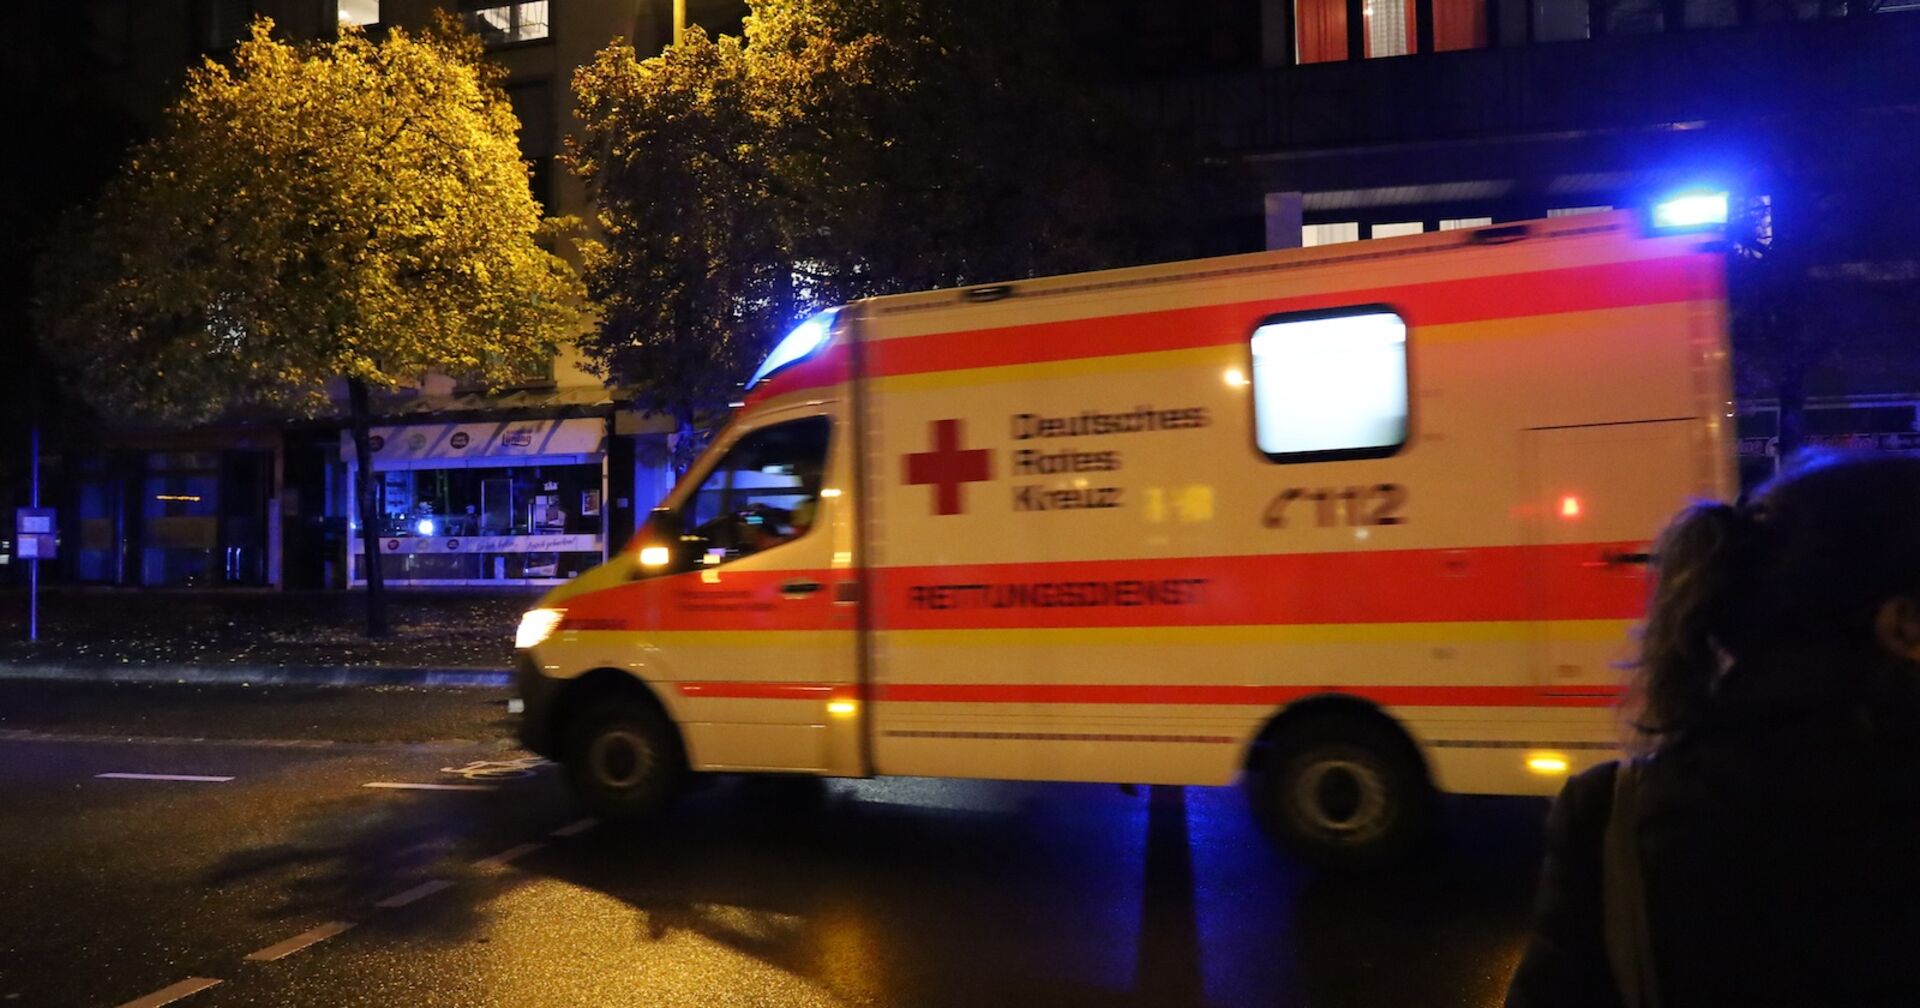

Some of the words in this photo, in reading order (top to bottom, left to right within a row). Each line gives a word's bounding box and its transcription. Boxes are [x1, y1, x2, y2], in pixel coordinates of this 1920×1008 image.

[1012, 405, 1211, 440] Deutsches
[1012, 450, 1124, 476] Rotes
[1012, 485, 1124, 512] Kreuz
[1311, 482, 1408, 528] 112
[908, 578, 1208, 610] RETTUNGSDIENST
